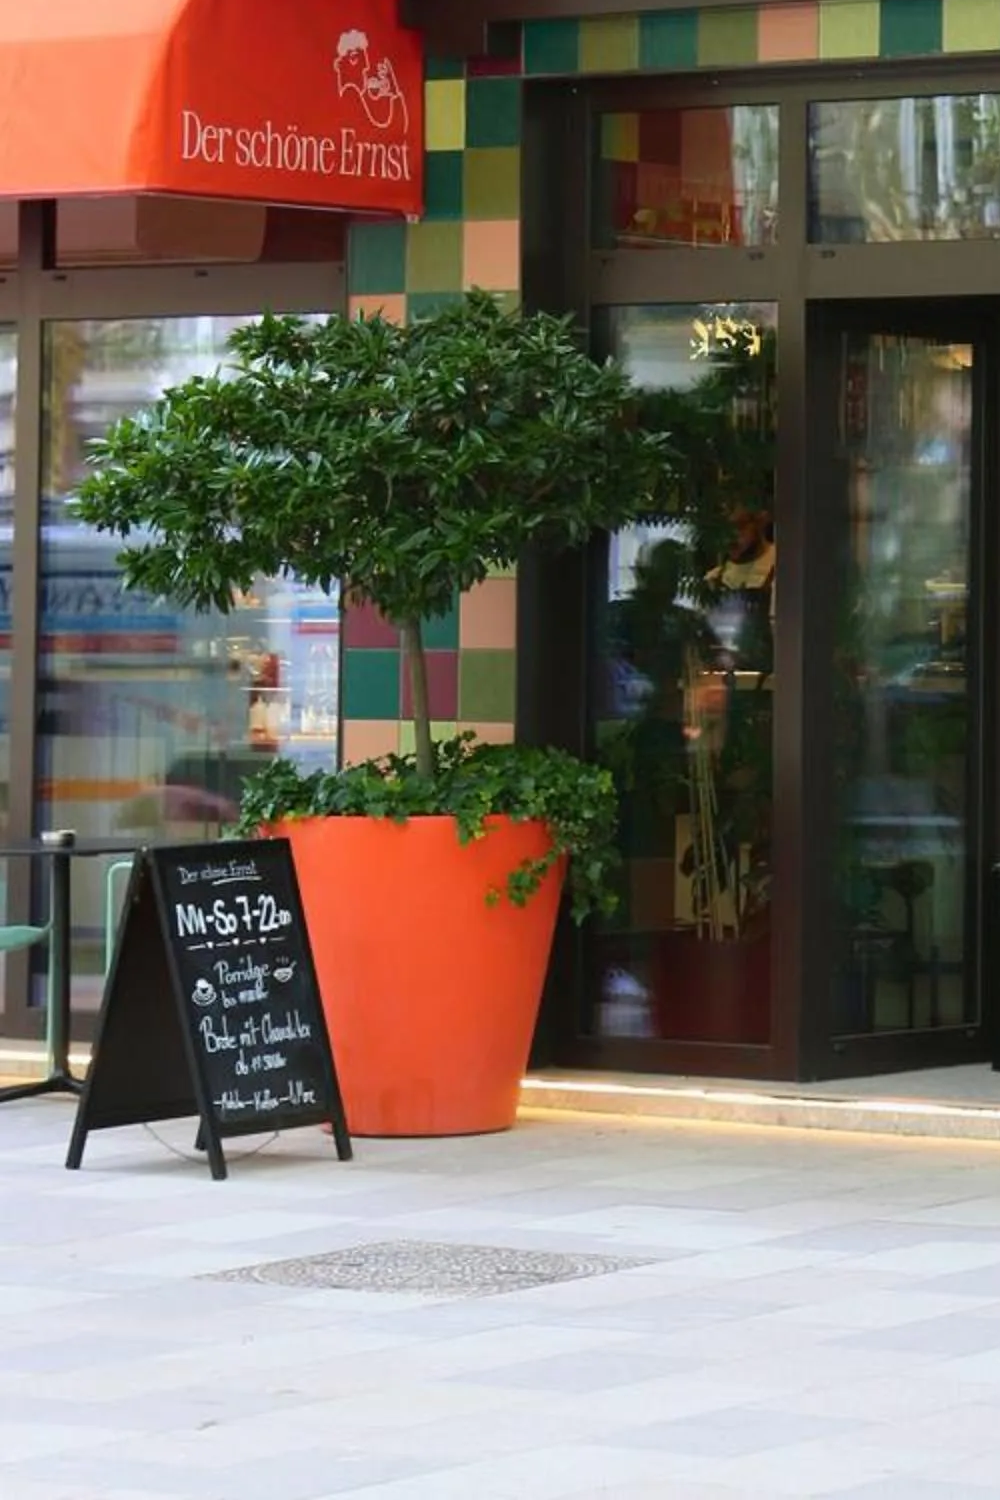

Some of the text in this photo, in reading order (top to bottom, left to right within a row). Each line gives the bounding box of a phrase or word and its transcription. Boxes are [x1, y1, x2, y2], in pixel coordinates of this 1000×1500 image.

[182, 110, 411, 181] Der schöne Ernst
[213, 954, 271, 989] Porridge
